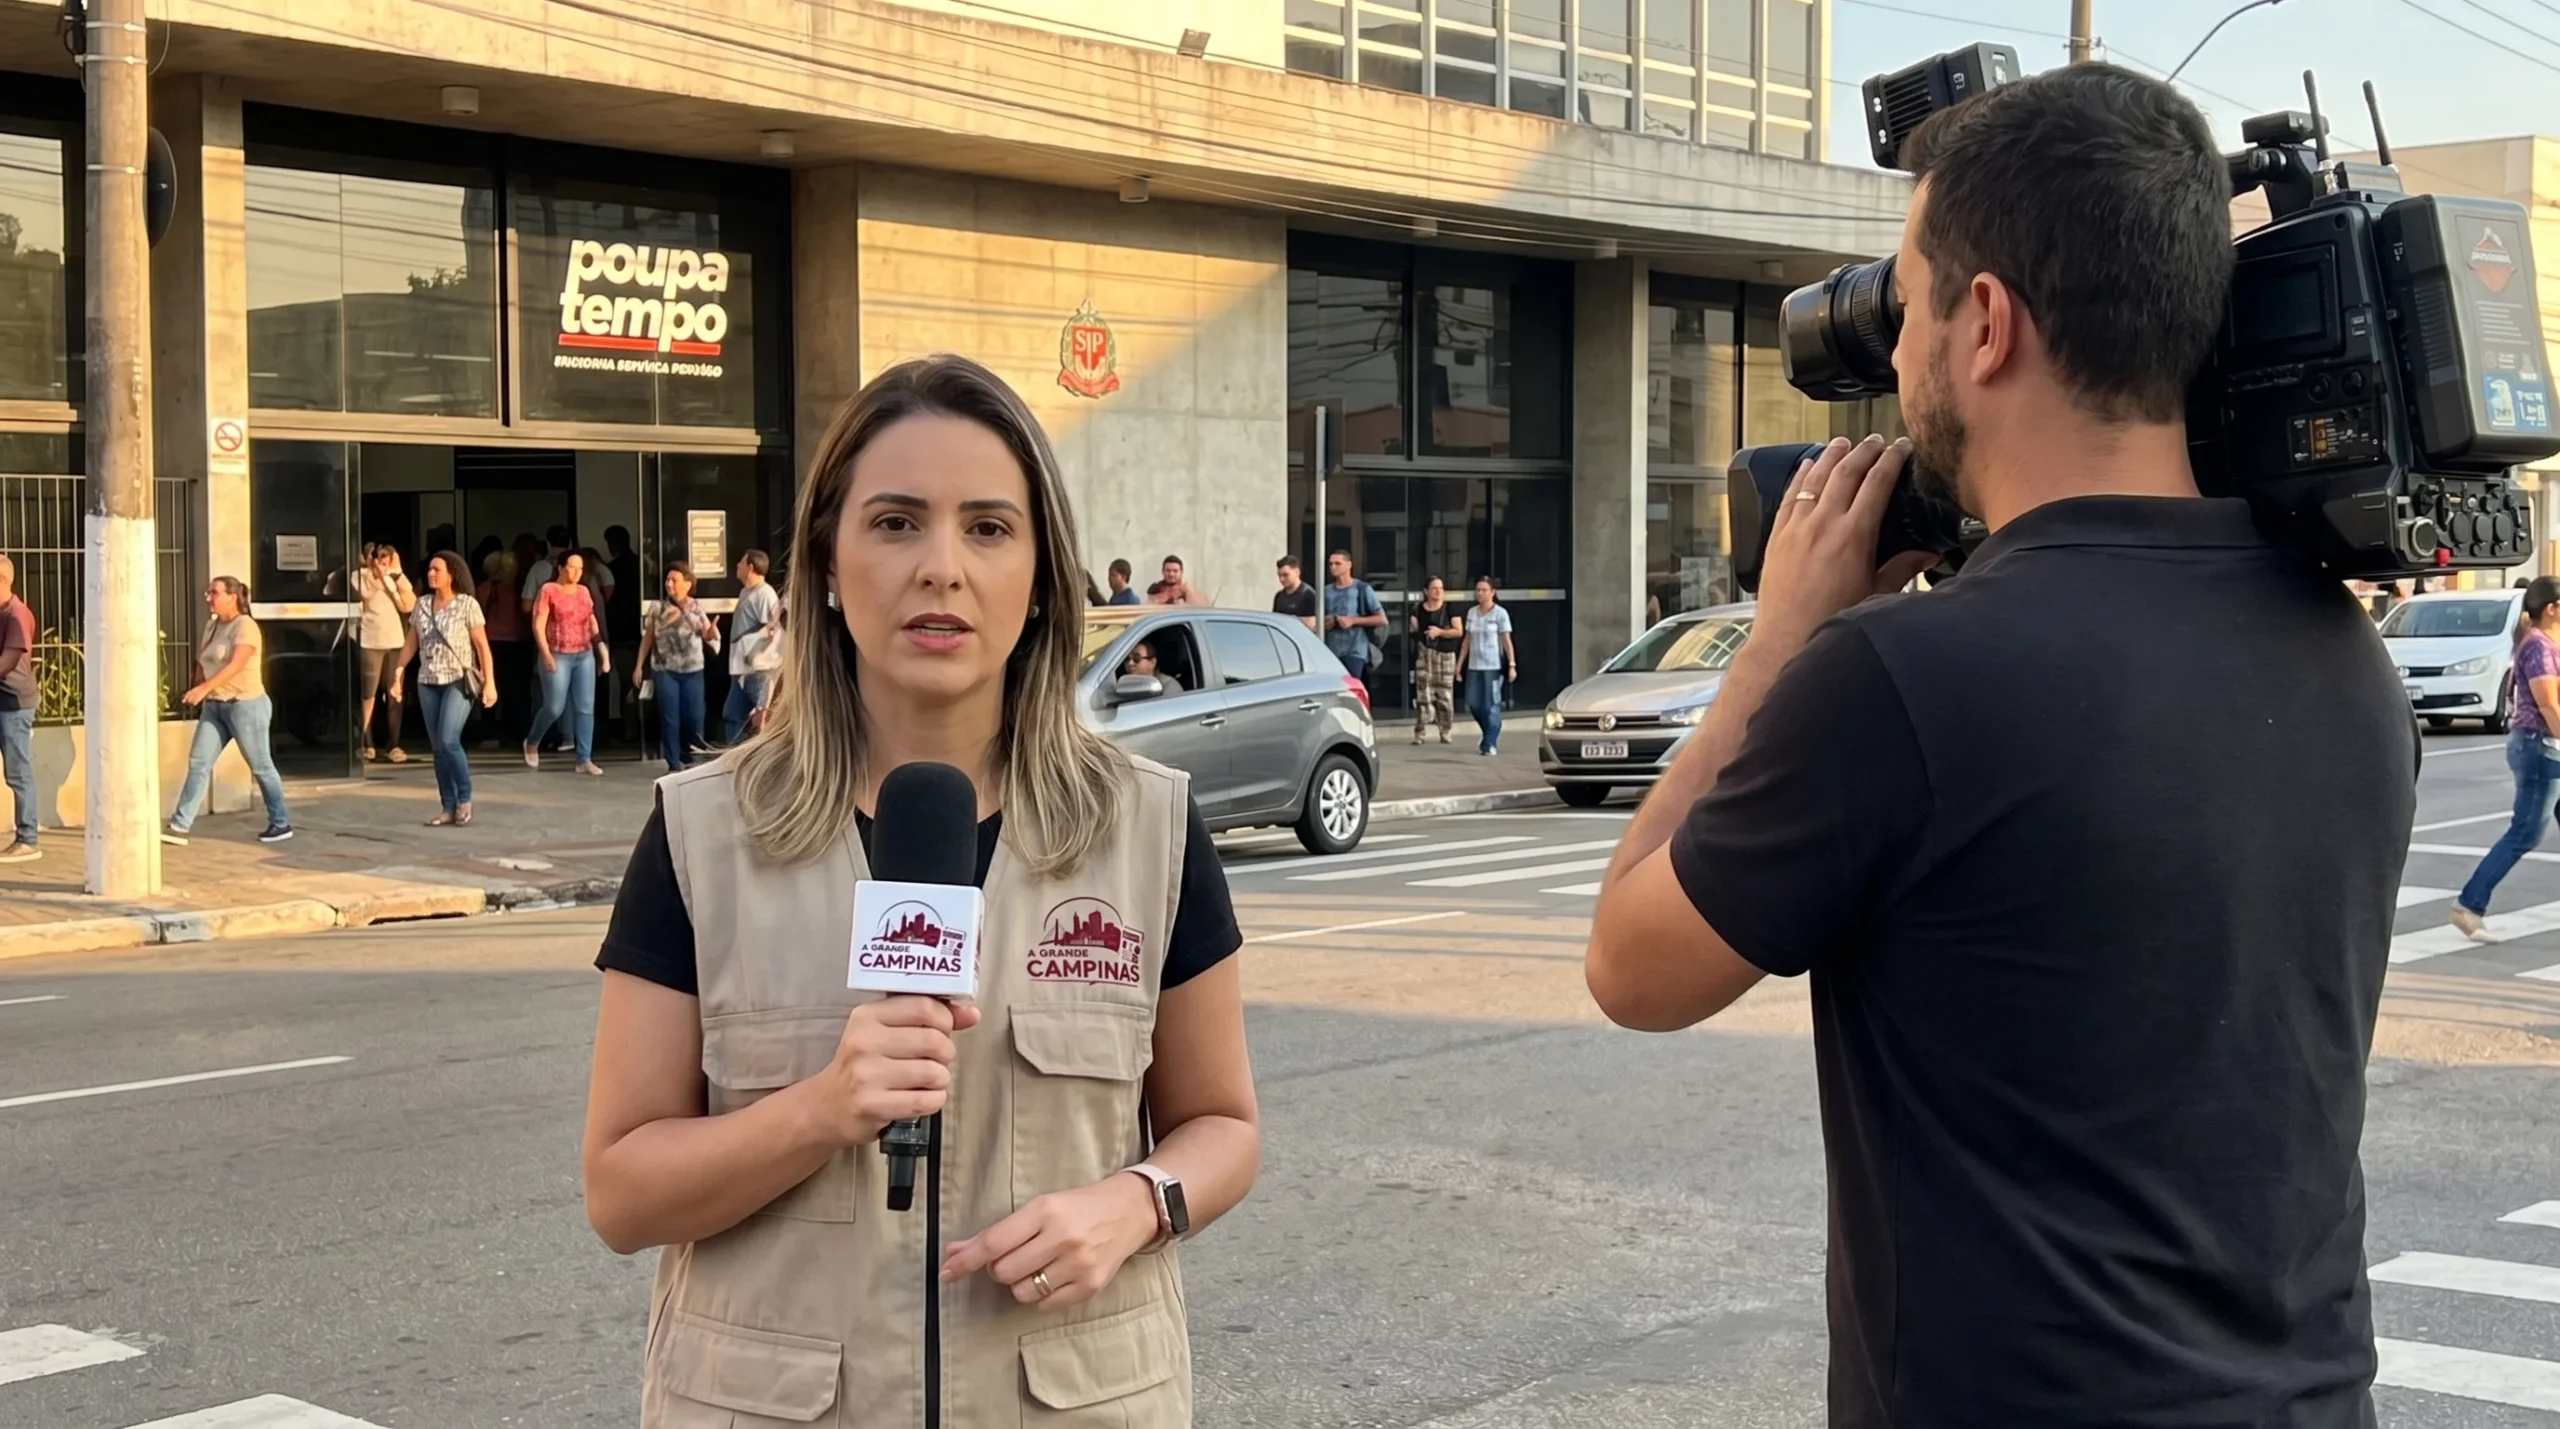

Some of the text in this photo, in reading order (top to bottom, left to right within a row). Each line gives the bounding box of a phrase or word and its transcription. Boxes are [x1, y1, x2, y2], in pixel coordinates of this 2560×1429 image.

[564, 239, 729, 299] poupa
[559, 291, 728, 352] tempo
[861, 943, 868, 951] A
[1027, 949, 1089, 957] A GRANDE
[859, 953, 962, 972] CAMPINAS
[1027, 959, 1140, 983] CAMPINAS
